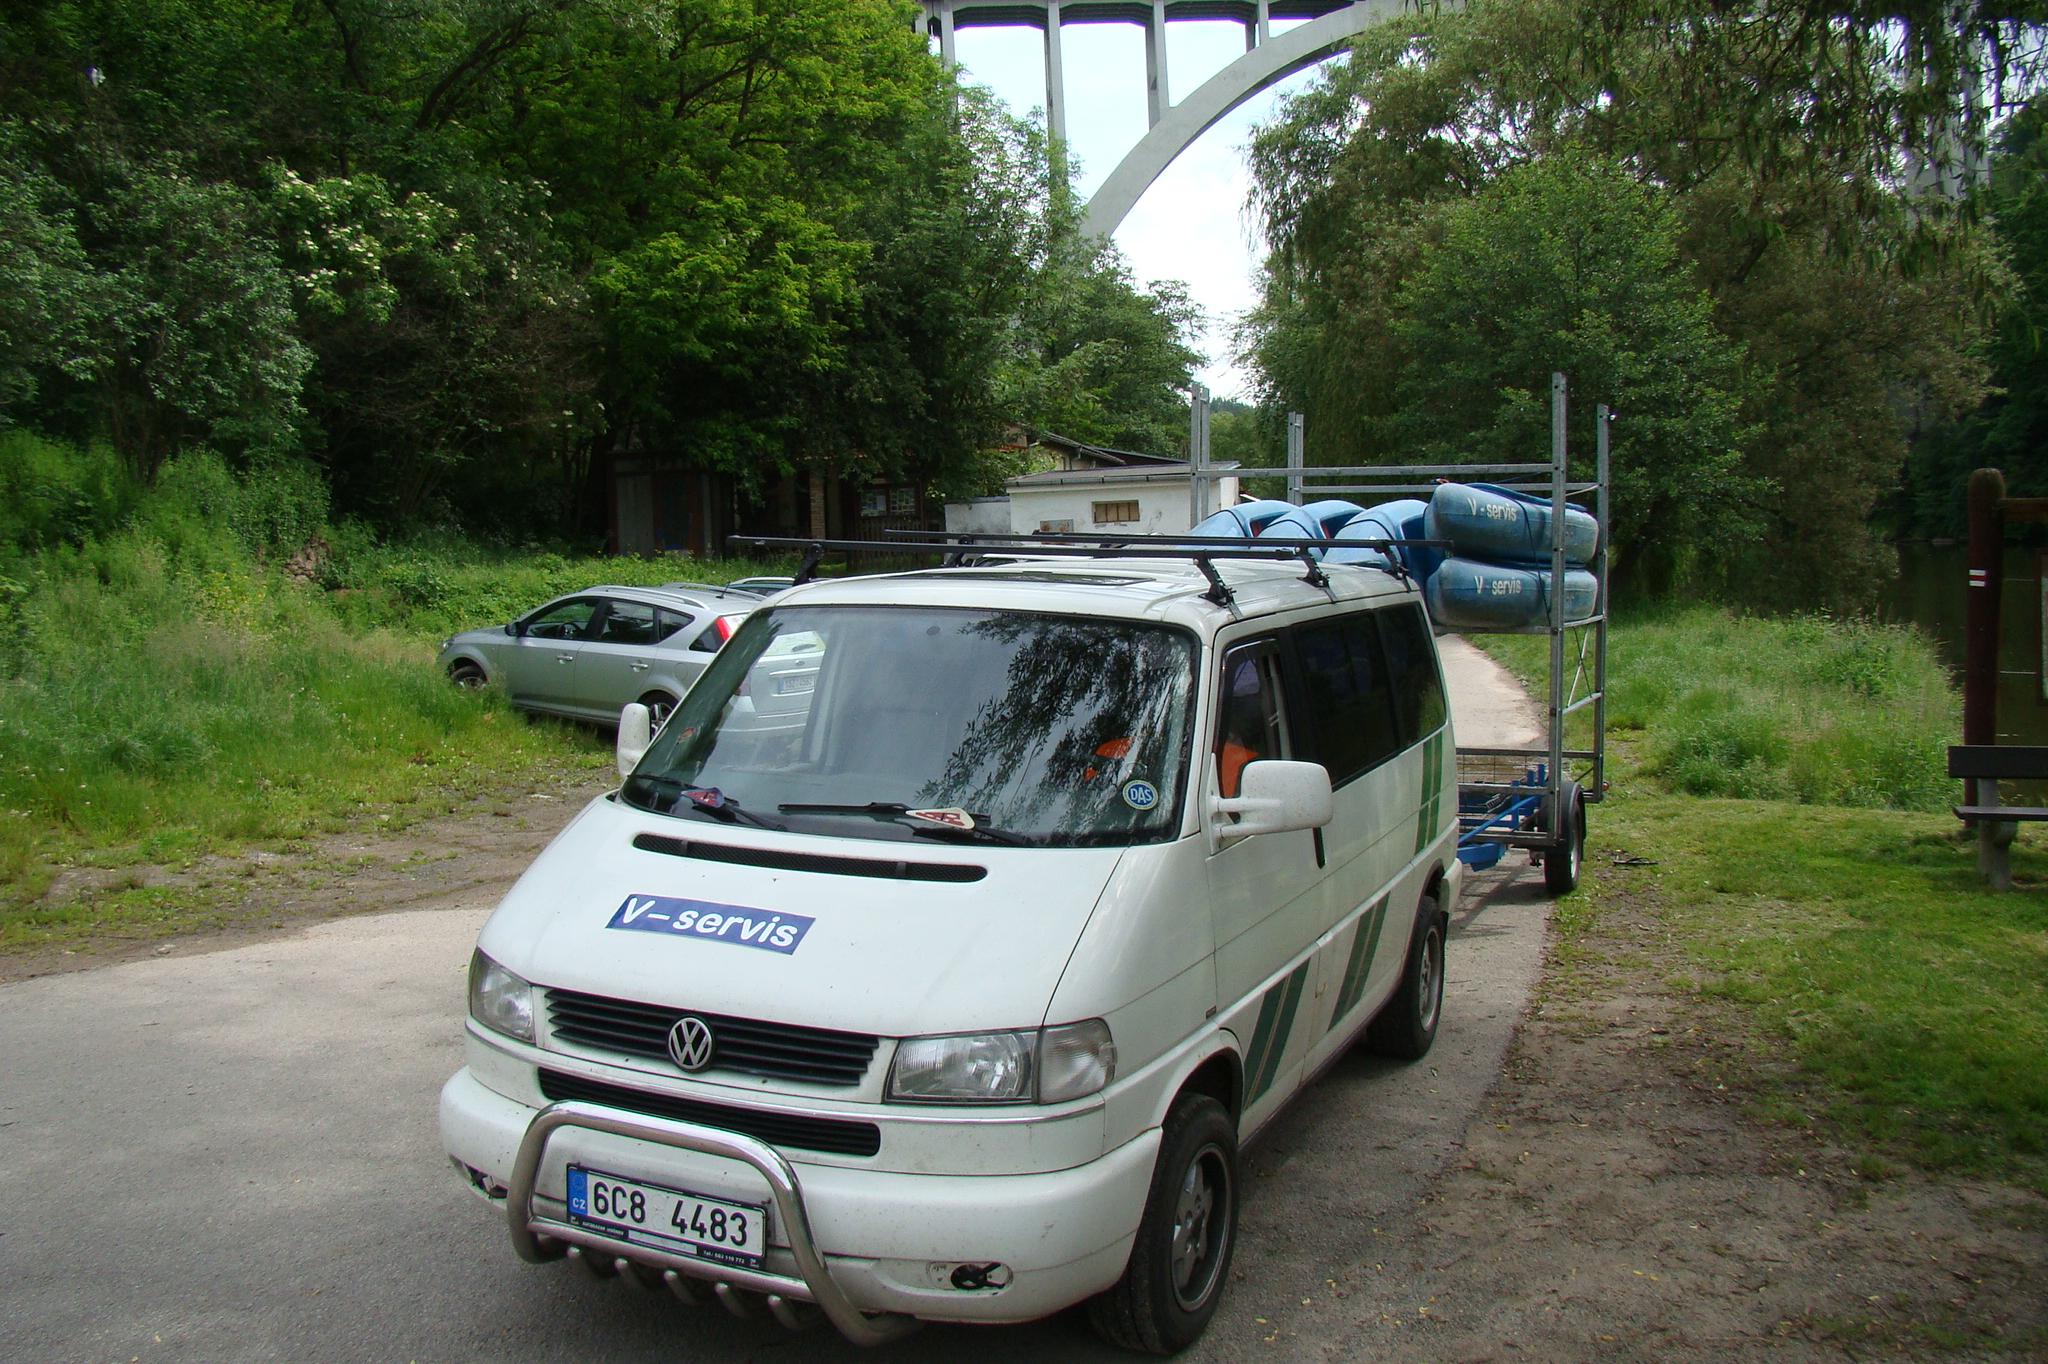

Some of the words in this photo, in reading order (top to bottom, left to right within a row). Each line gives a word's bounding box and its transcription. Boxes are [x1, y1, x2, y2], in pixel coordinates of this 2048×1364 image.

[1486, 503, 1517, 522] servis
[1492, 576, 1521, 595] servis
[1130, 786, 1153, 804] DAS
[572, 1197, 586, 1210] CZ
[593, 1181, 646, 1224] 6C8
[671, 1199, 747, 1246] 4483
